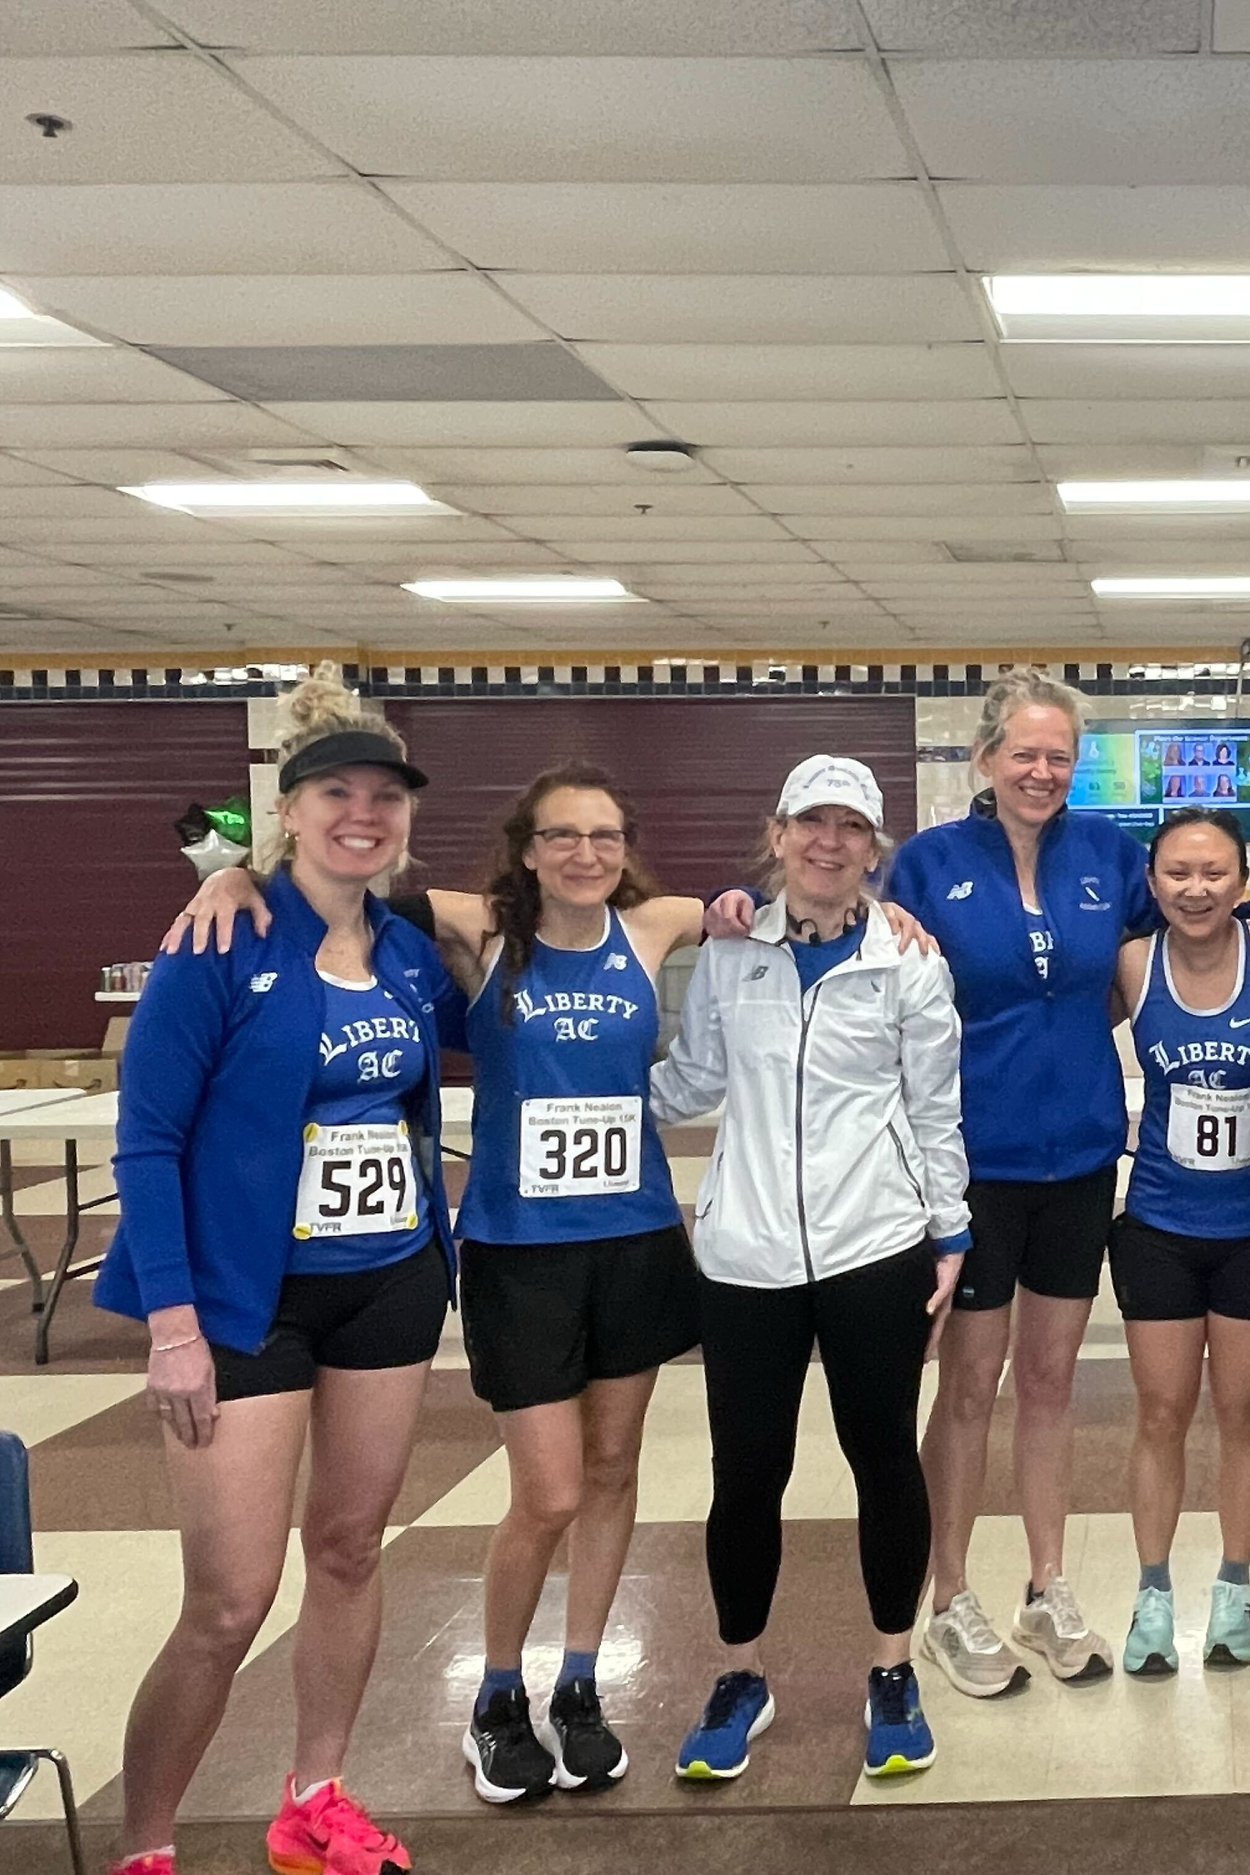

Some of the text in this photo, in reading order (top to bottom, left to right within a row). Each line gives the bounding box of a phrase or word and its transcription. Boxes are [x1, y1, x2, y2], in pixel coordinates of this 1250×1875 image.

[319, 1017, 420, 1066] LIBERT
[553, 1017, 599, 1041] AC
[539, 1127, 627, 1180] 320
[1196, 1115, 1237, 1157] 81
[318, 1157, 407, 1218] 529
